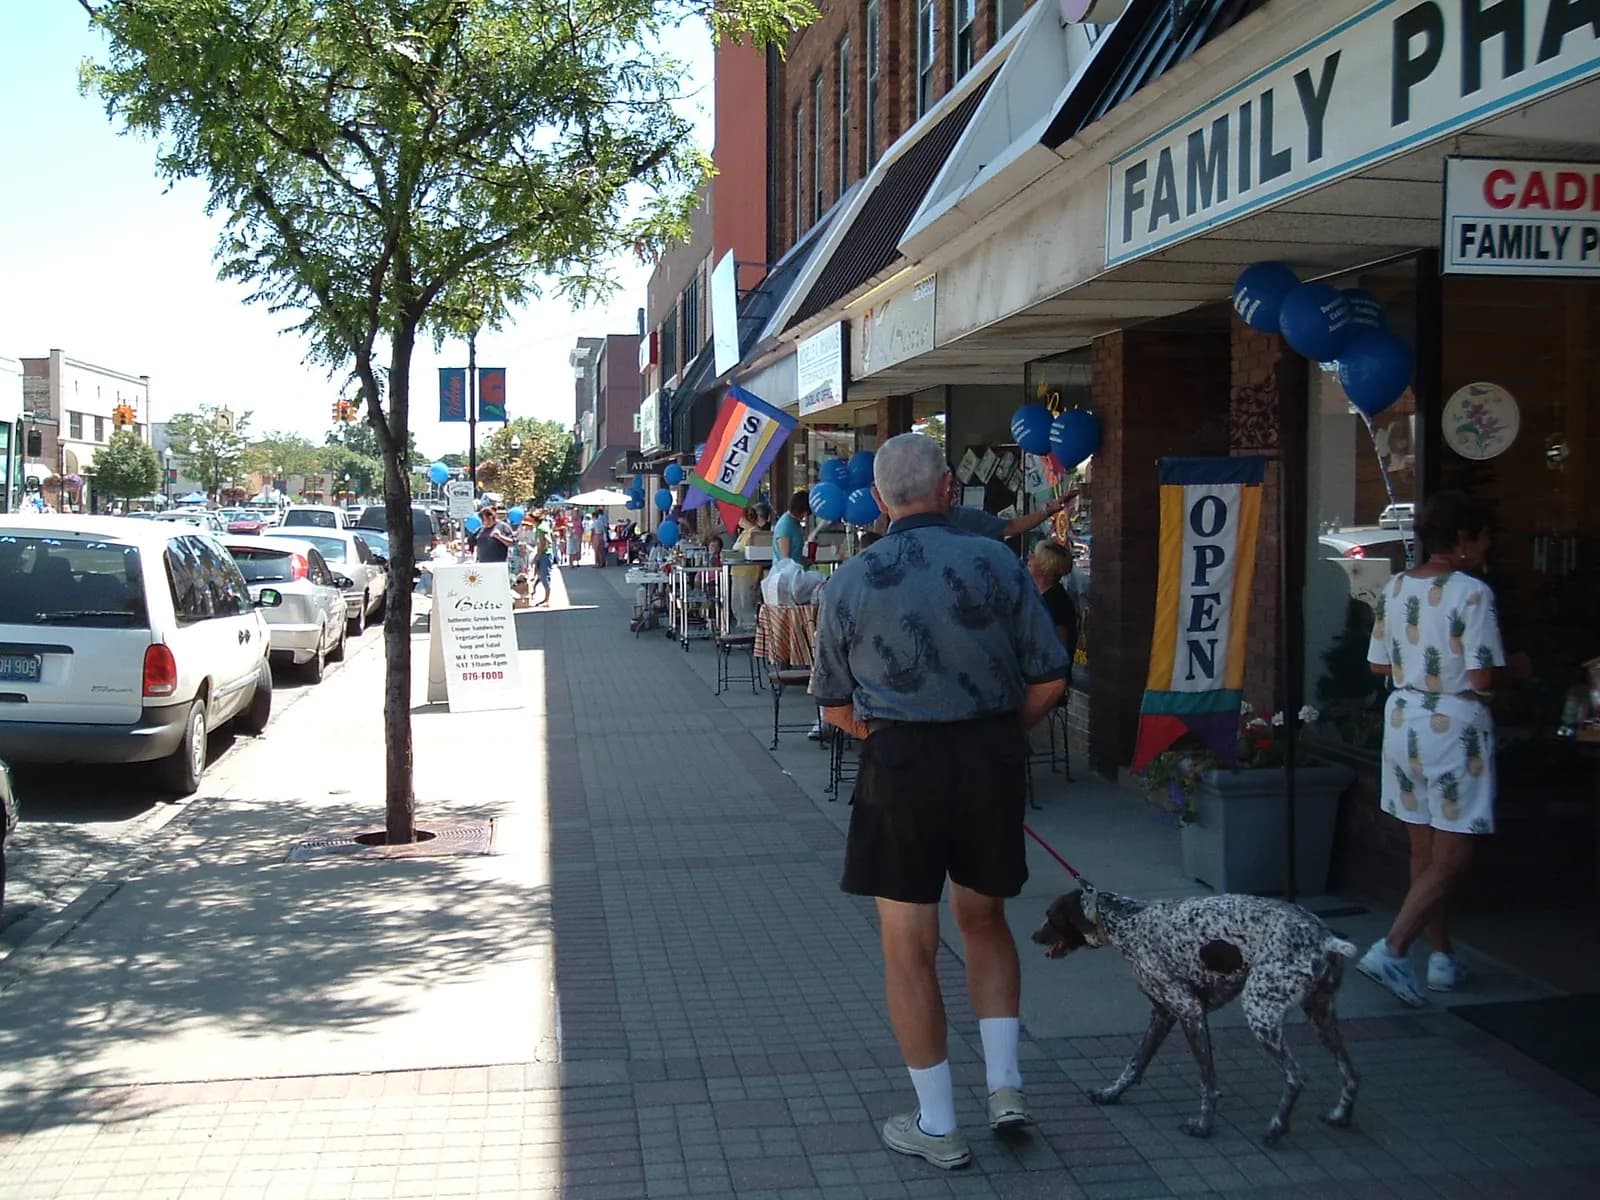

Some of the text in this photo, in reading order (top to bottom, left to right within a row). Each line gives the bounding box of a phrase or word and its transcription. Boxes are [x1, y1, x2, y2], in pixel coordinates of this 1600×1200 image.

[1122, 48, 1342, 244] FAMILY
[1458, 223, 1572, 261] FAMILY
[719, 415, 760, 485] SALE
[631, 461, 654, 471] ATM
[1184, 494, 1228, 681] OPEN
[455, 595, 504, 611] Bistro
[14, 660, 37, 674] 909
[462, 671, 504, 681] 876-FOOD
